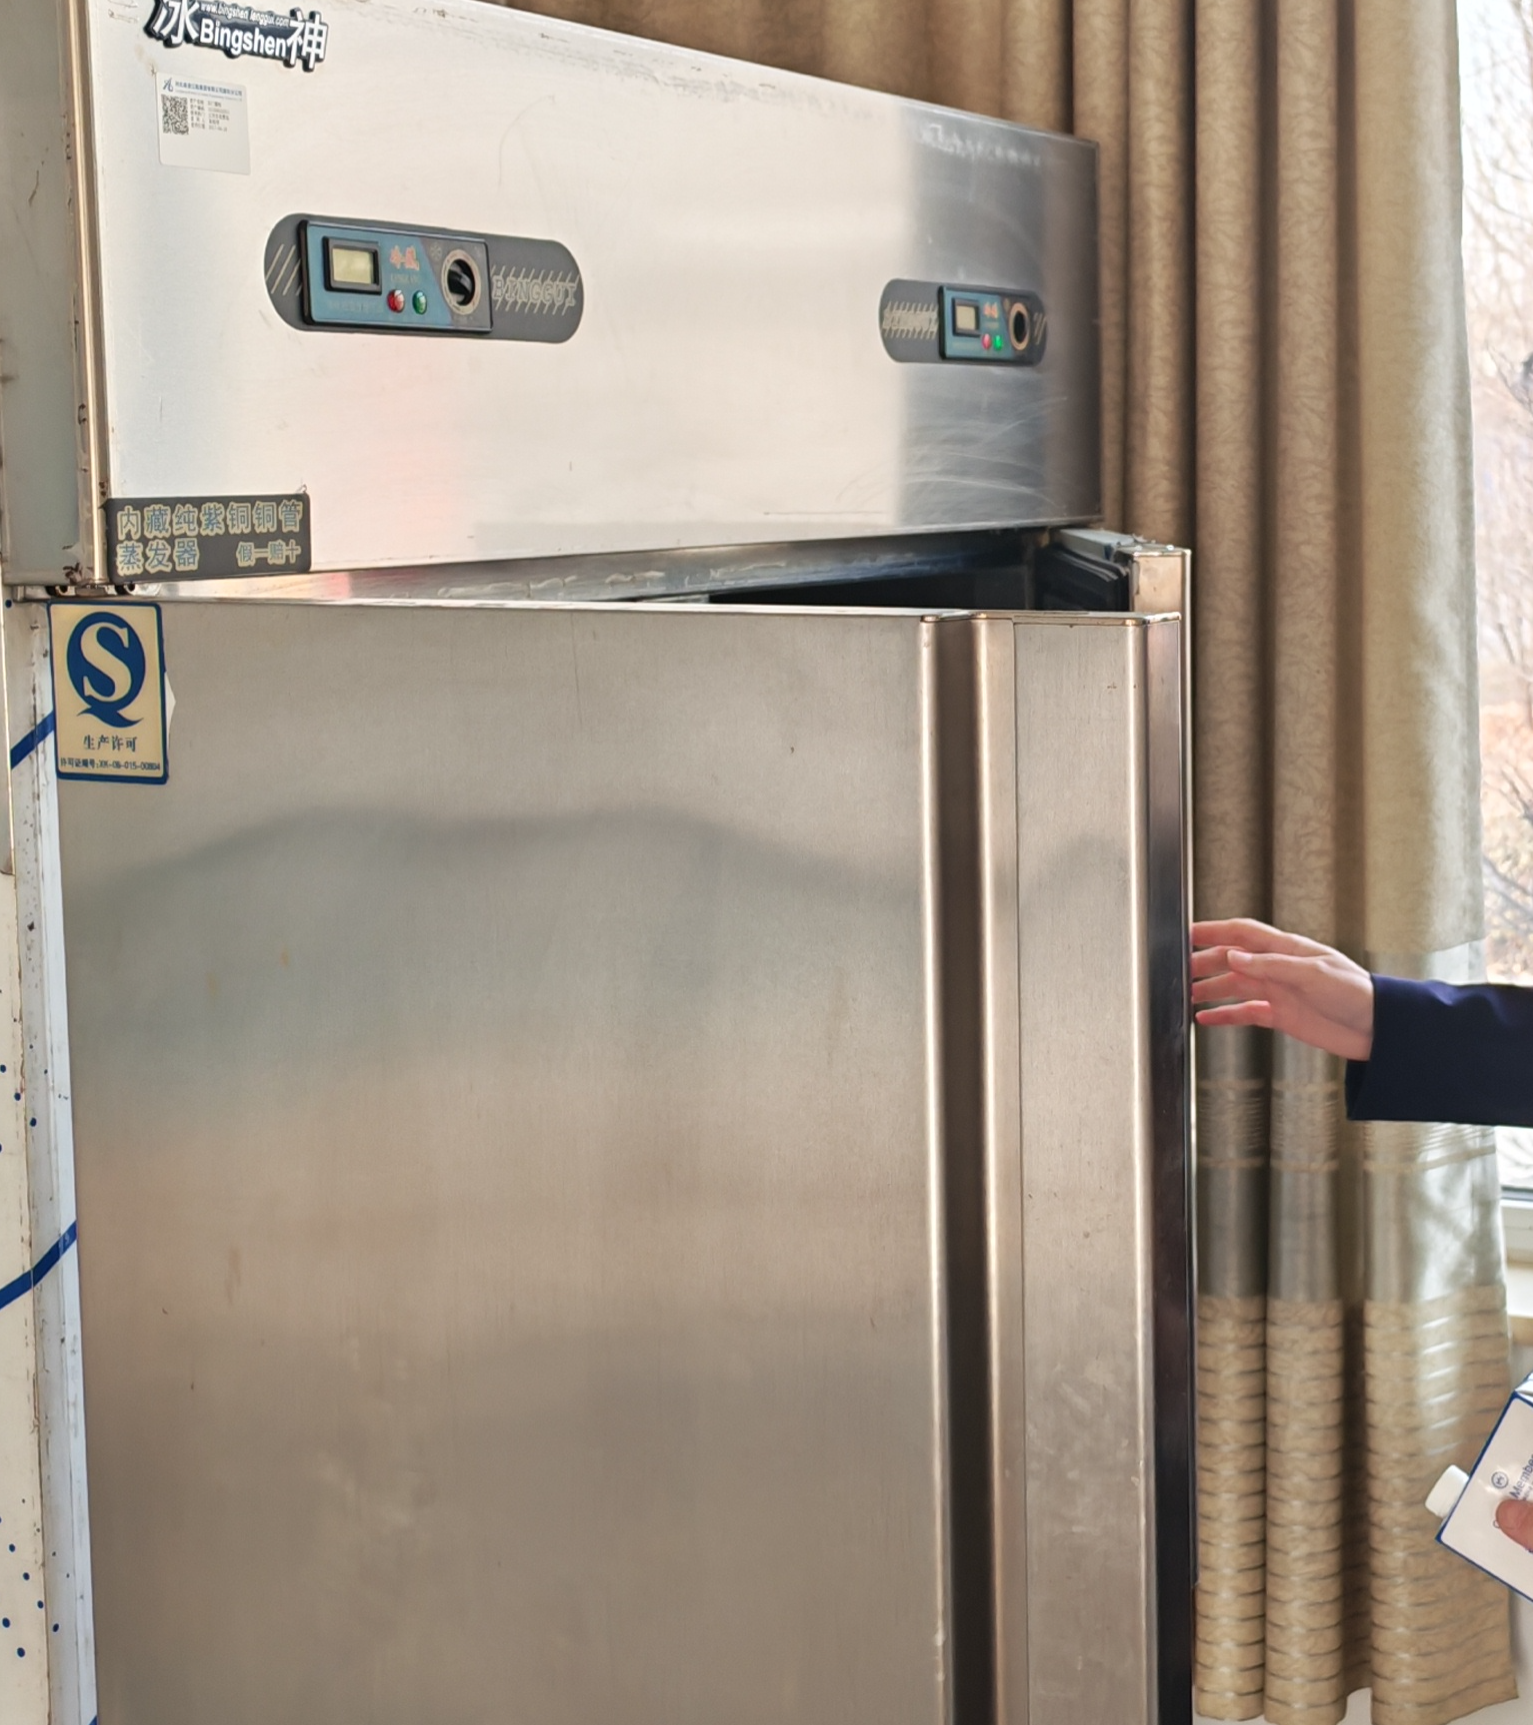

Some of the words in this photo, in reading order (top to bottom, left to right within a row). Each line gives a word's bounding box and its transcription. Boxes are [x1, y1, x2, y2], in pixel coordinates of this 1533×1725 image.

[201, 18, 287, 58] Bingshen
[287, 11, 328, 69] 神
[117, 500, 303, 540] 内藏纯紫铜铜管
[116, 538, 199, 576] 蒸发器
[236, 539, 301, 567] 假一赔十
[83, 734, 137, 752] 生产许可
